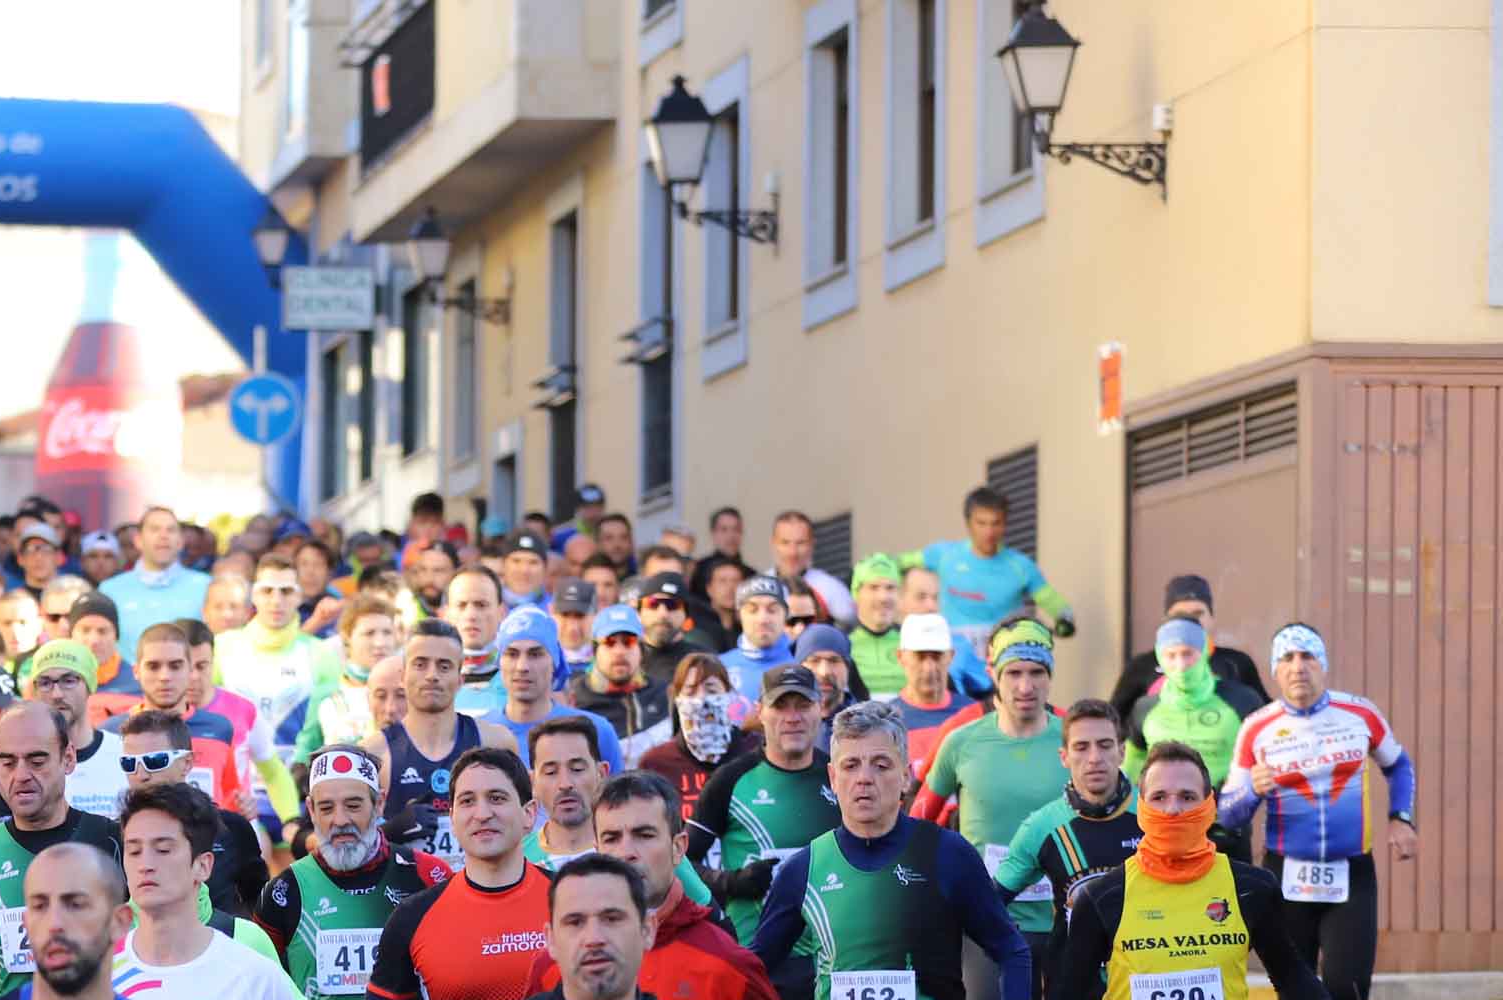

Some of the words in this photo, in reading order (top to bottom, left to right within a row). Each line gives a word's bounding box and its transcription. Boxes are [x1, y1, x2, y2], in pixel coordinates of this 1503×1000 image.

[10, 132, 42, 154] de
[1297, 867, 1335, 886] 485
[1121, 937, 1169, 953] MESA
[1173, 932, 1247, 948] VALORIO
[1169, 949, 1207, 957] ZAMORA
